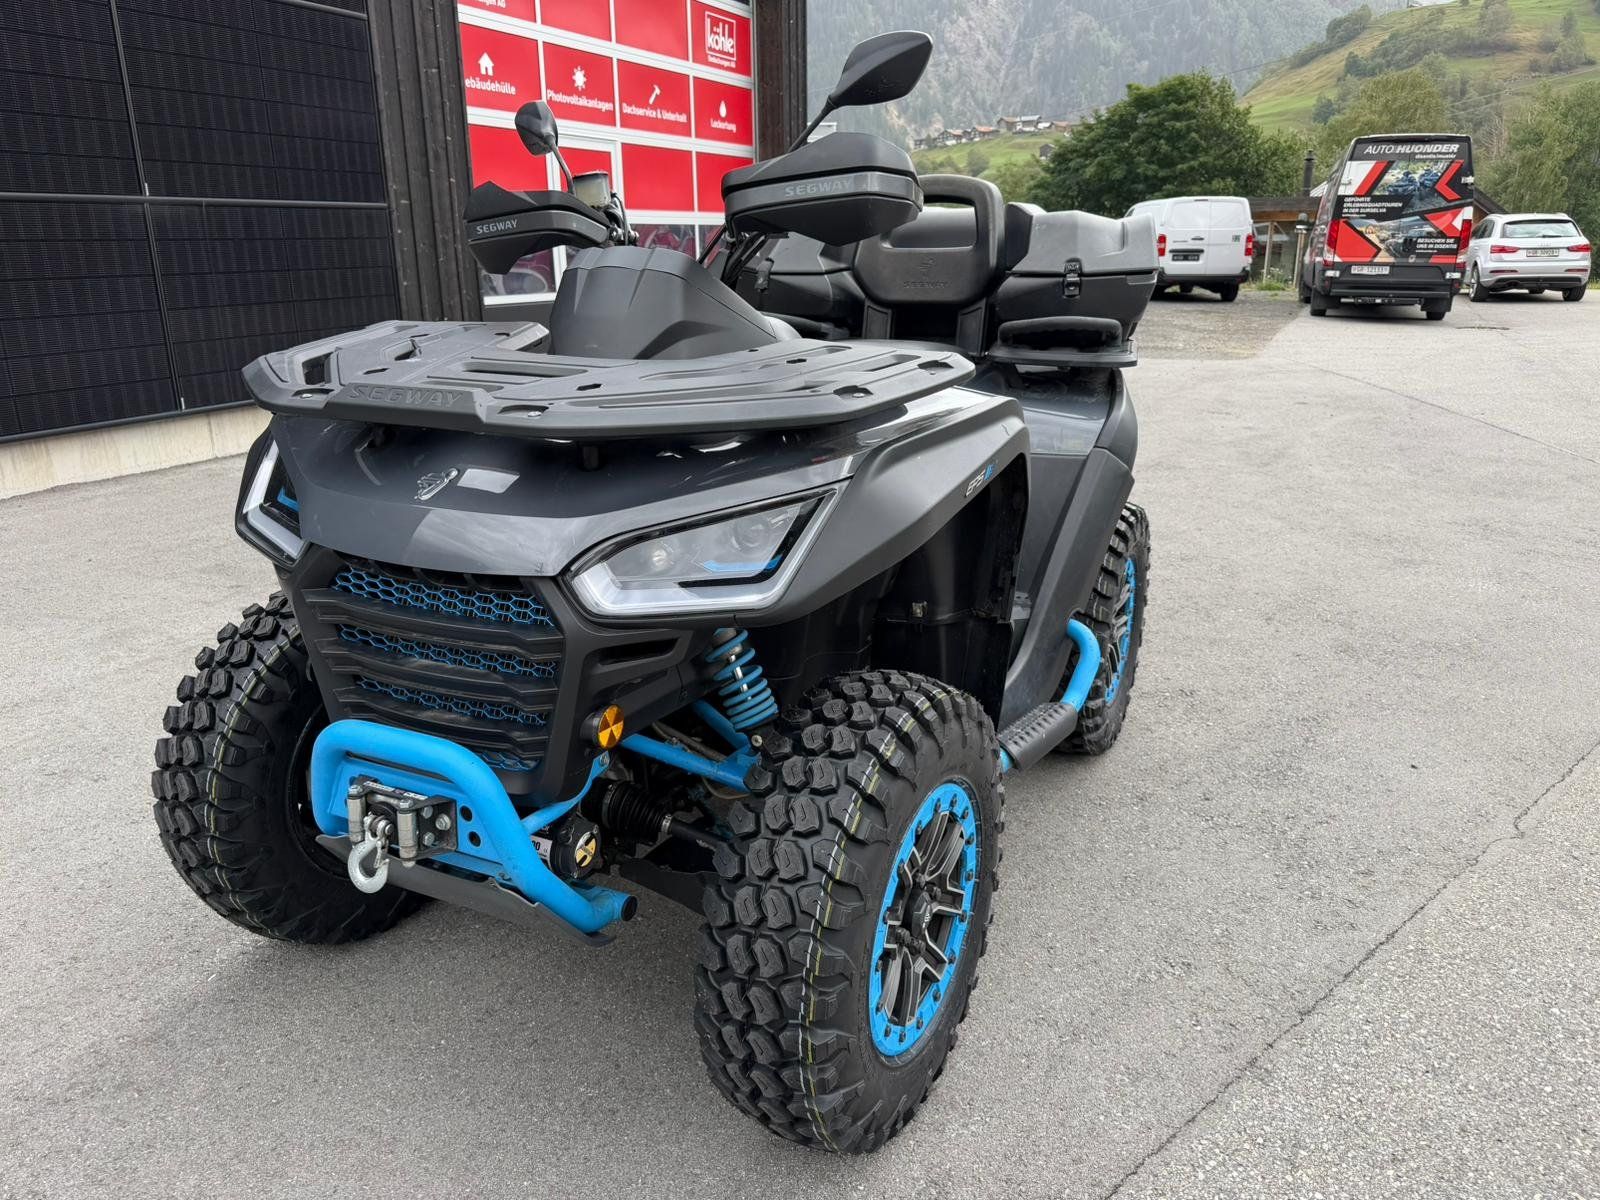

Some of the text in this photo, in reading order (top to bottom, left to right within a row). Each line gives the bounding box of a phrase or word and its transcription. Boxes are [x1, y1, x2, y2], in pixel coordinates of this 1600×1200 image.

[707, 18, 734, 54] köhle
[464, 78, 516, 95] ebäudehülle
[546, 89, 614, 112] Photovoltaikanlagen
[1363, 144, 1460, 154] AUTO HUONDER
[785, 178, 855, 197] SEGWAY
[476, 219, 518, 235] SEGWAY
[348, 385, 462, 407] SEGWAY
